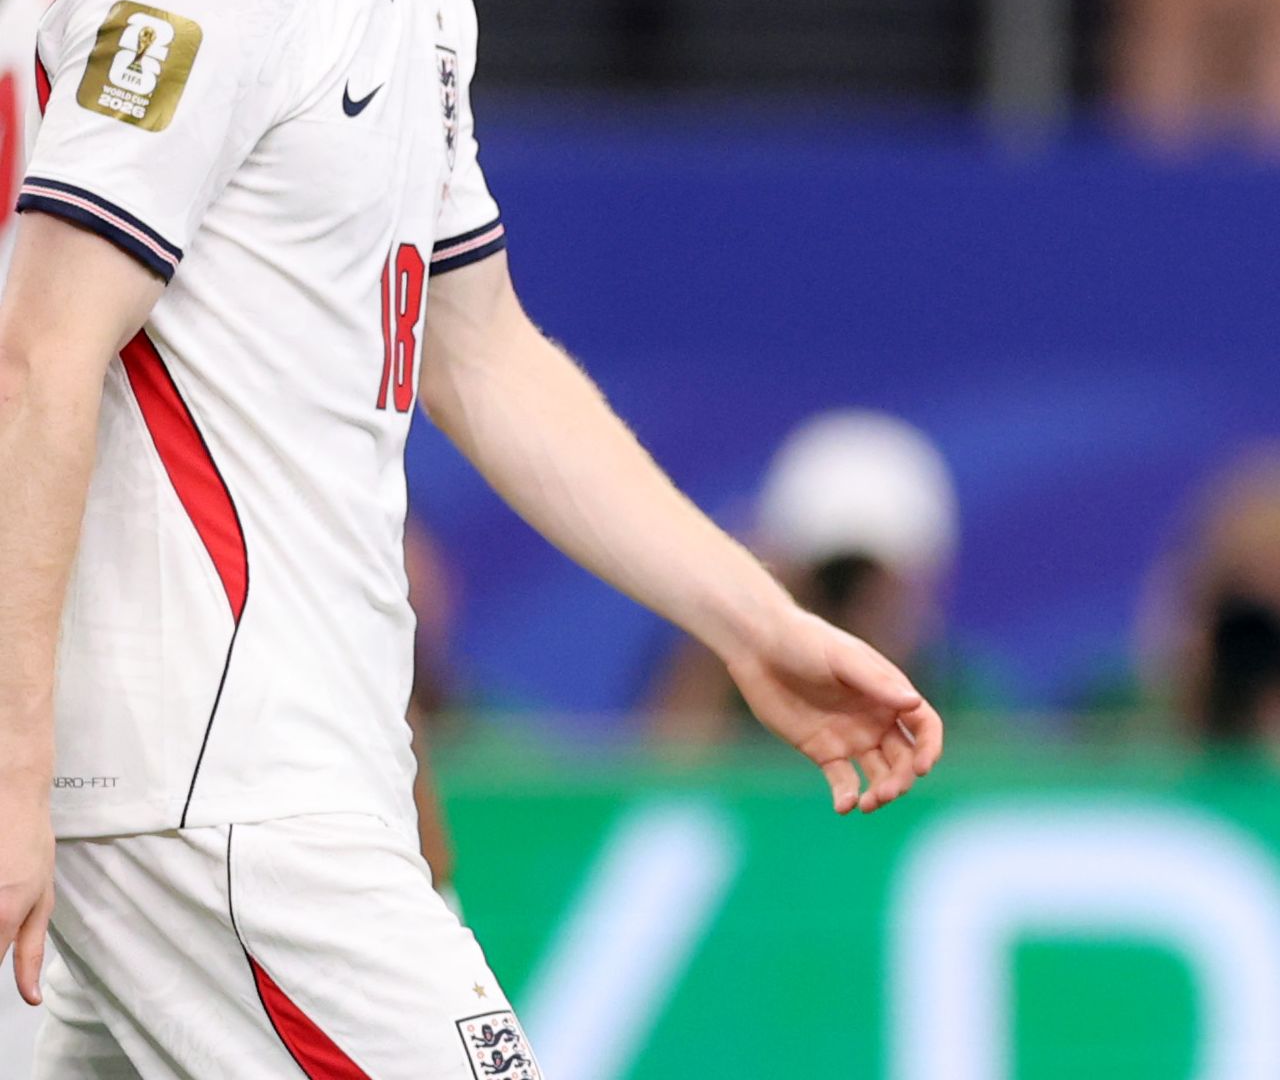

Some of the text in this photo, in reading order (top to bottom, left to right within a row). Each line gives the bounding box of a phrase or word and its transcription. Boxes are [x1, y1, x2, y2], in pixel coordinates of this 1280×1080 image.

[121, 72, 142, 87] FIFA
[98, 94, 146, 119] 2026
[102, 85, 149, 107] WORLD CUP
[376, 241, 425, 413] 18
